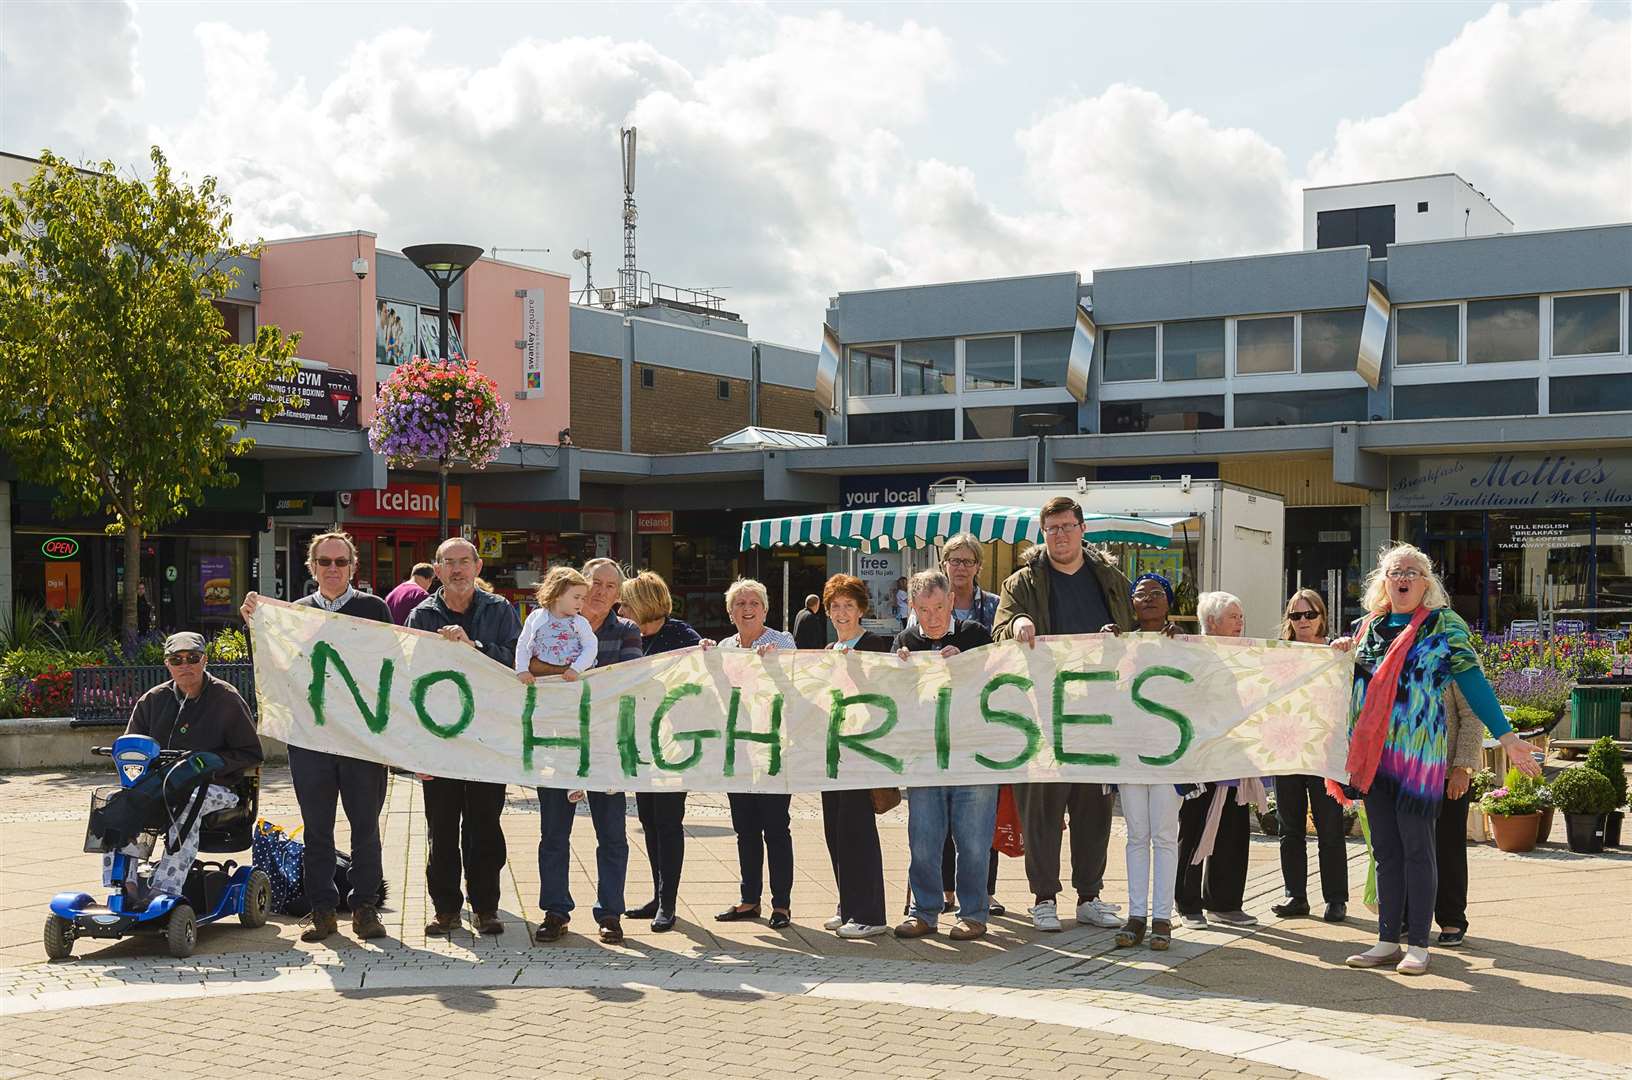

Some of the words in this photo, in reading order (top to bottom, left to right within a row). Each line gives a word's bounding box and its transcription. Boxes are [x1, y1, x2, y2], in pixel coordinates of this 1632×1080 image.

[528, 299, 536, 330] square
[527, 332, 536, 369] swanley
[298, 371, 322, 386] GYM
[328, 382, 353, 391] TOTAL
[302, 388, 325, 398] BOXING
[1470, 455, 1609, 488] Mollie's
[846, 491, 879, 507] your
[884, 488, 921, 503] local
[1440, 491, 1539, 506] Traditional
[1545, 489, 1574, 504] Pie
[46, 541, 74, 554] OPEN
[860, 556, 888, 569] free
[47, 579, 58, 588] Dig
[306, 640, 476, 739] NO
[521, 679, 785, 779] HIGH
[825, 664, 1196, 780] RISES
